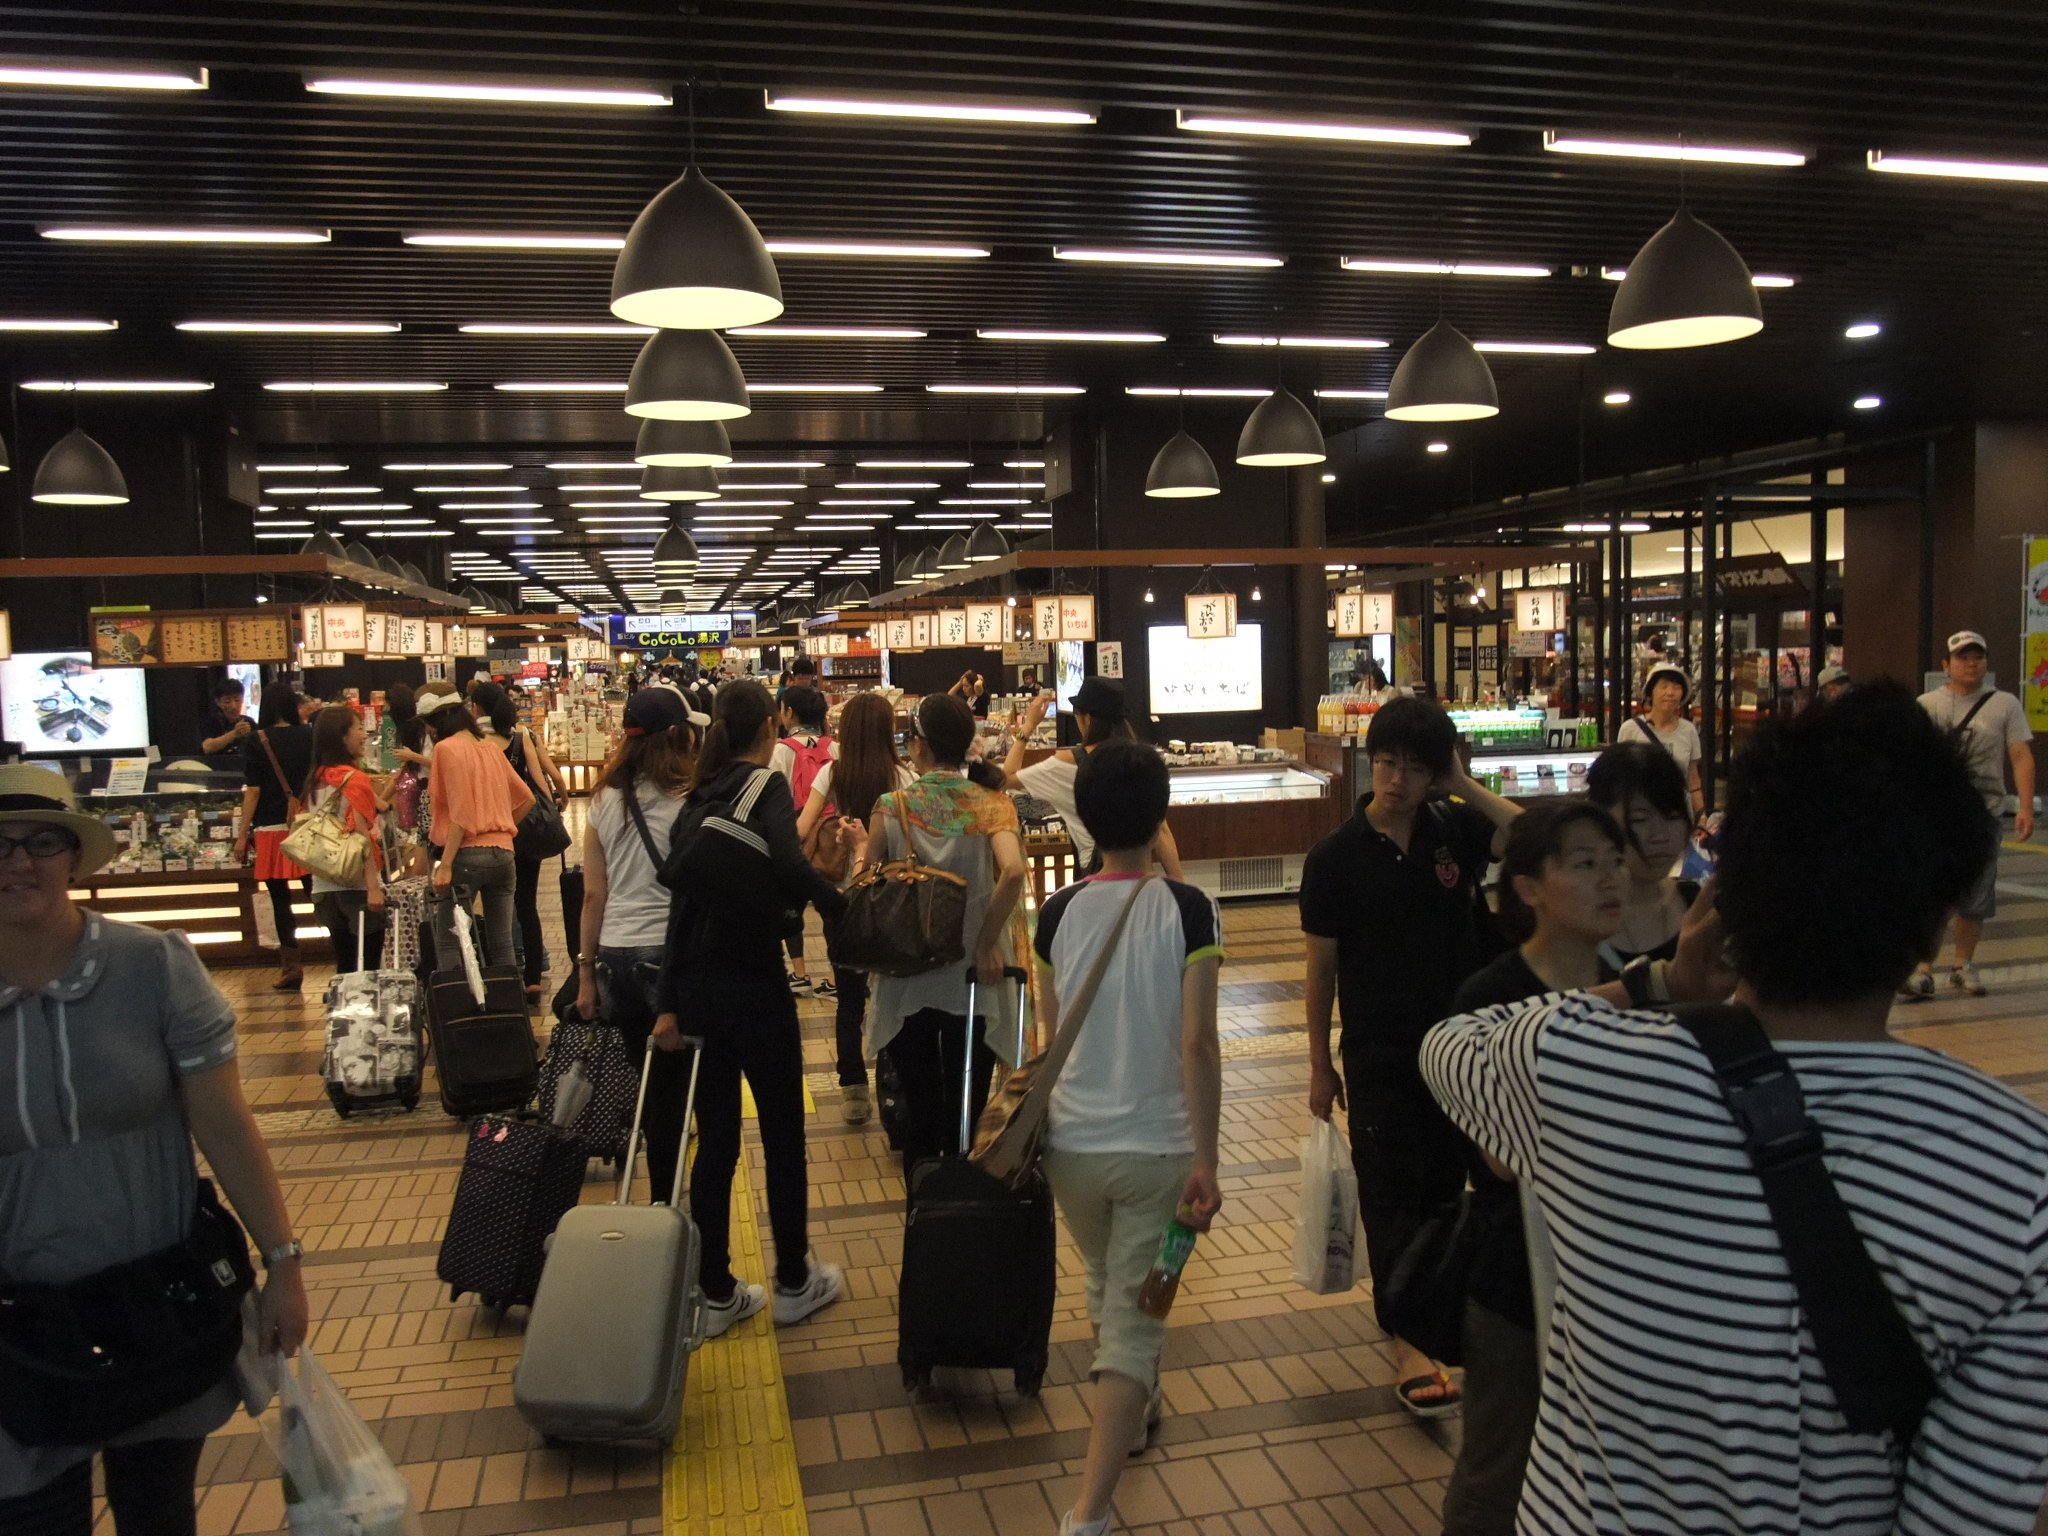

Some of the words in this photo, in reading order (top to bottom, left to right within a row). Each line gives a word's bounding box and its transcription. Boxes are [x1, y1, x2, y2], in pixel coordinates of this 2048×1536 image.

[1063, 608, 1077, 618] 中央
[327, 618, 346, 627] 中央
[697, 632, 720, 644] 湯沢
